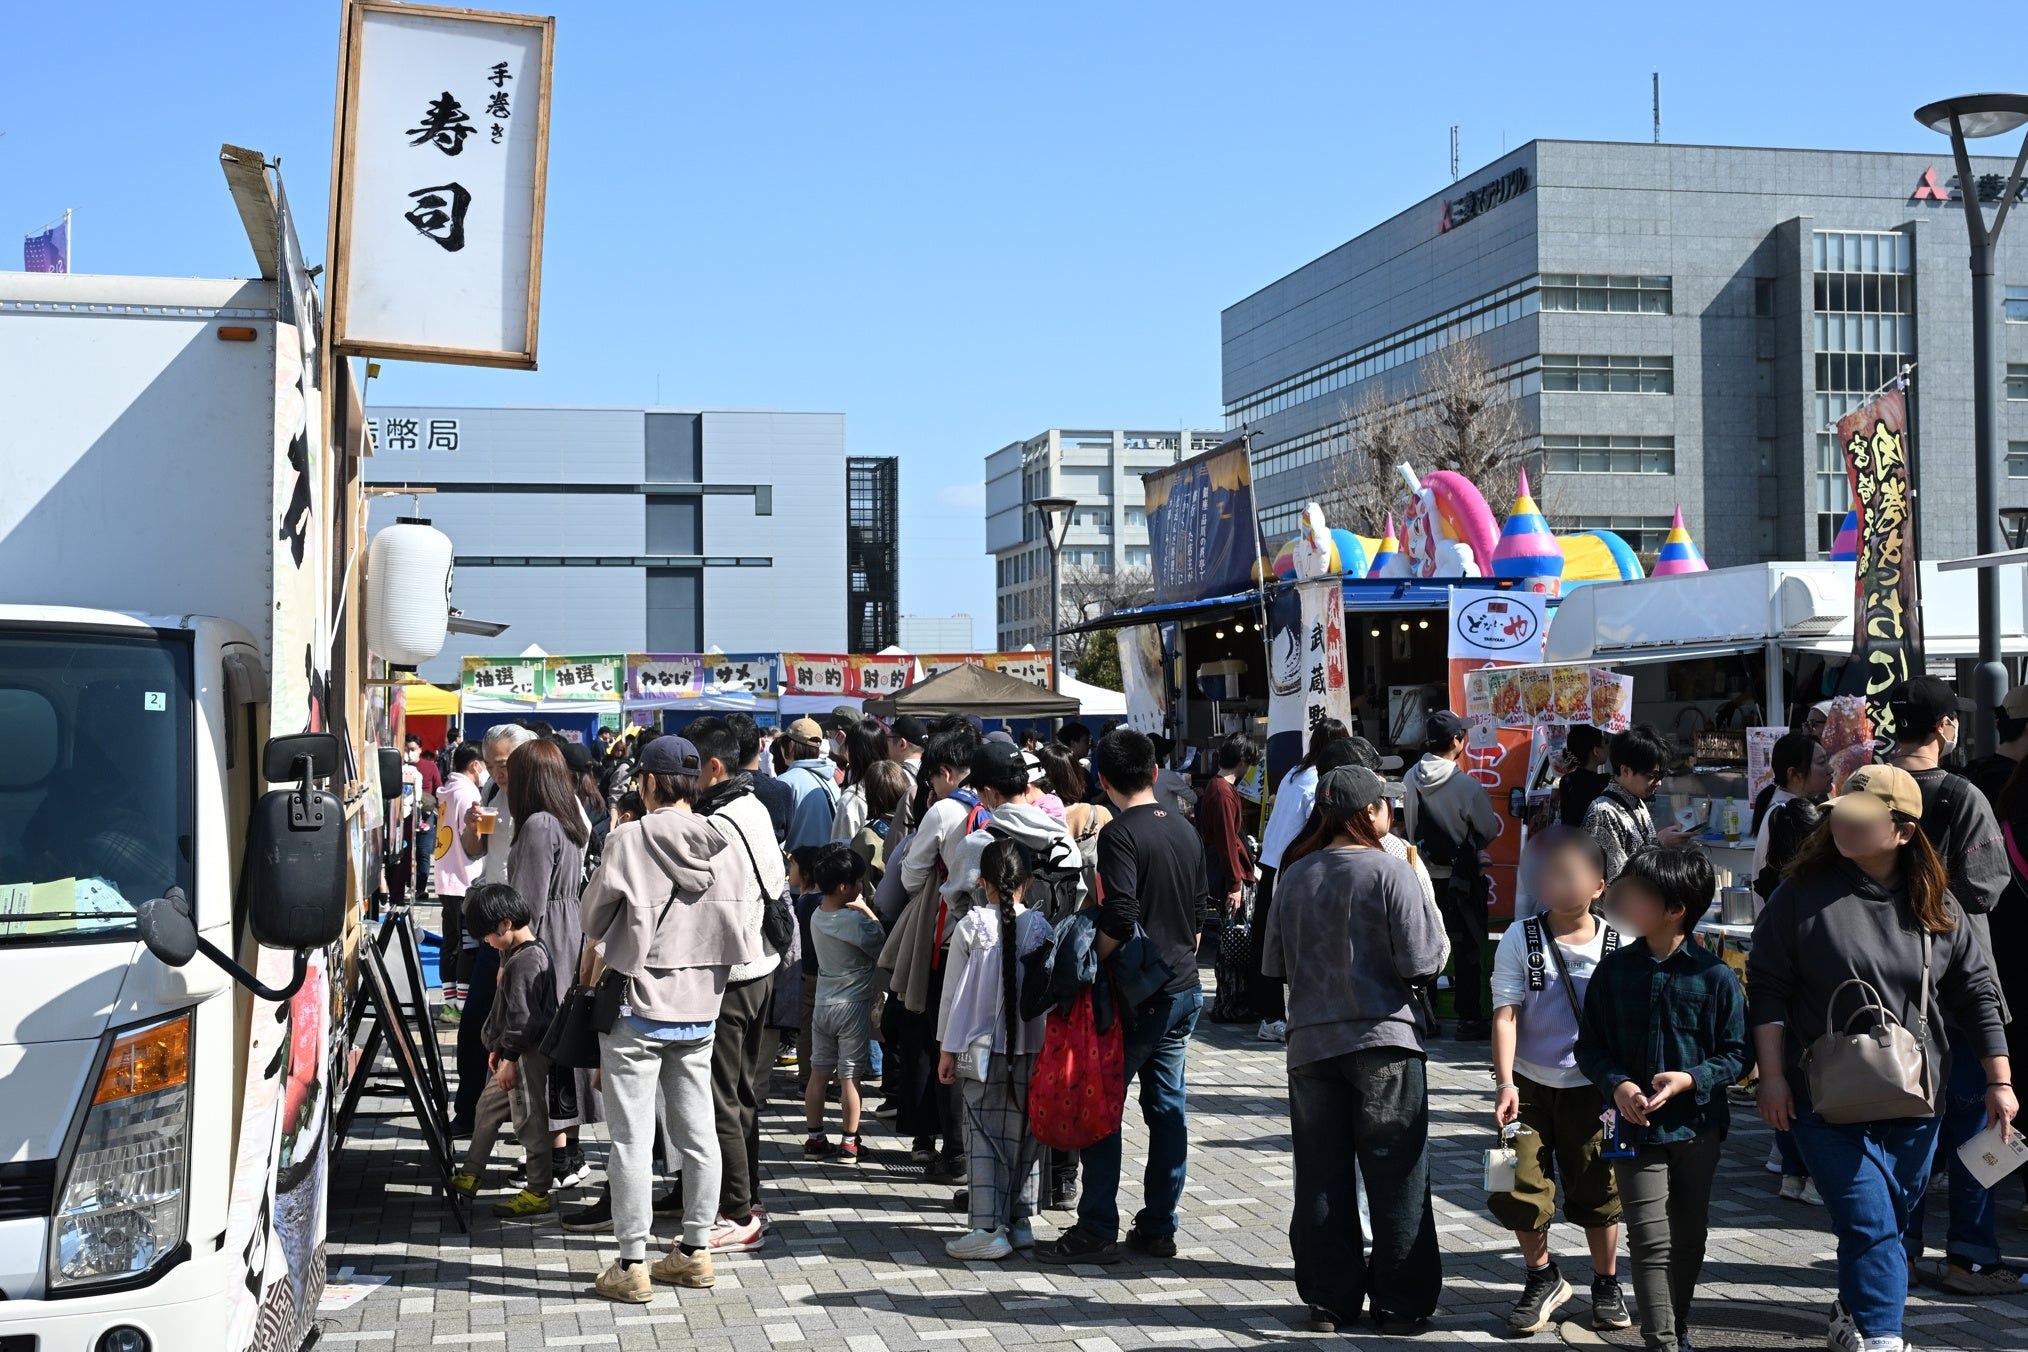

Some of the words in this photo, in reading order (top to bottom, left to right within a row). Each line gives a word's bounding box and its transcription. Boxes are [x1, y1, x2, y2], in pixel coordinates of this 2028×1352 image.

[485, 61, 513, 145] 手巻き
[404, 91, 478, 252] 寿司
[641, 670, 692, 687] わなげ
[797, 667, 842, 688] 射的
[863, 668, 905, 689] 射的
[150, 693, 158, 704] 2
[1527, 925, 1539, 944] CUTE
[1605, 931, 1618, 953] CUTE
[1531, 970, 1542, 987] OVE
